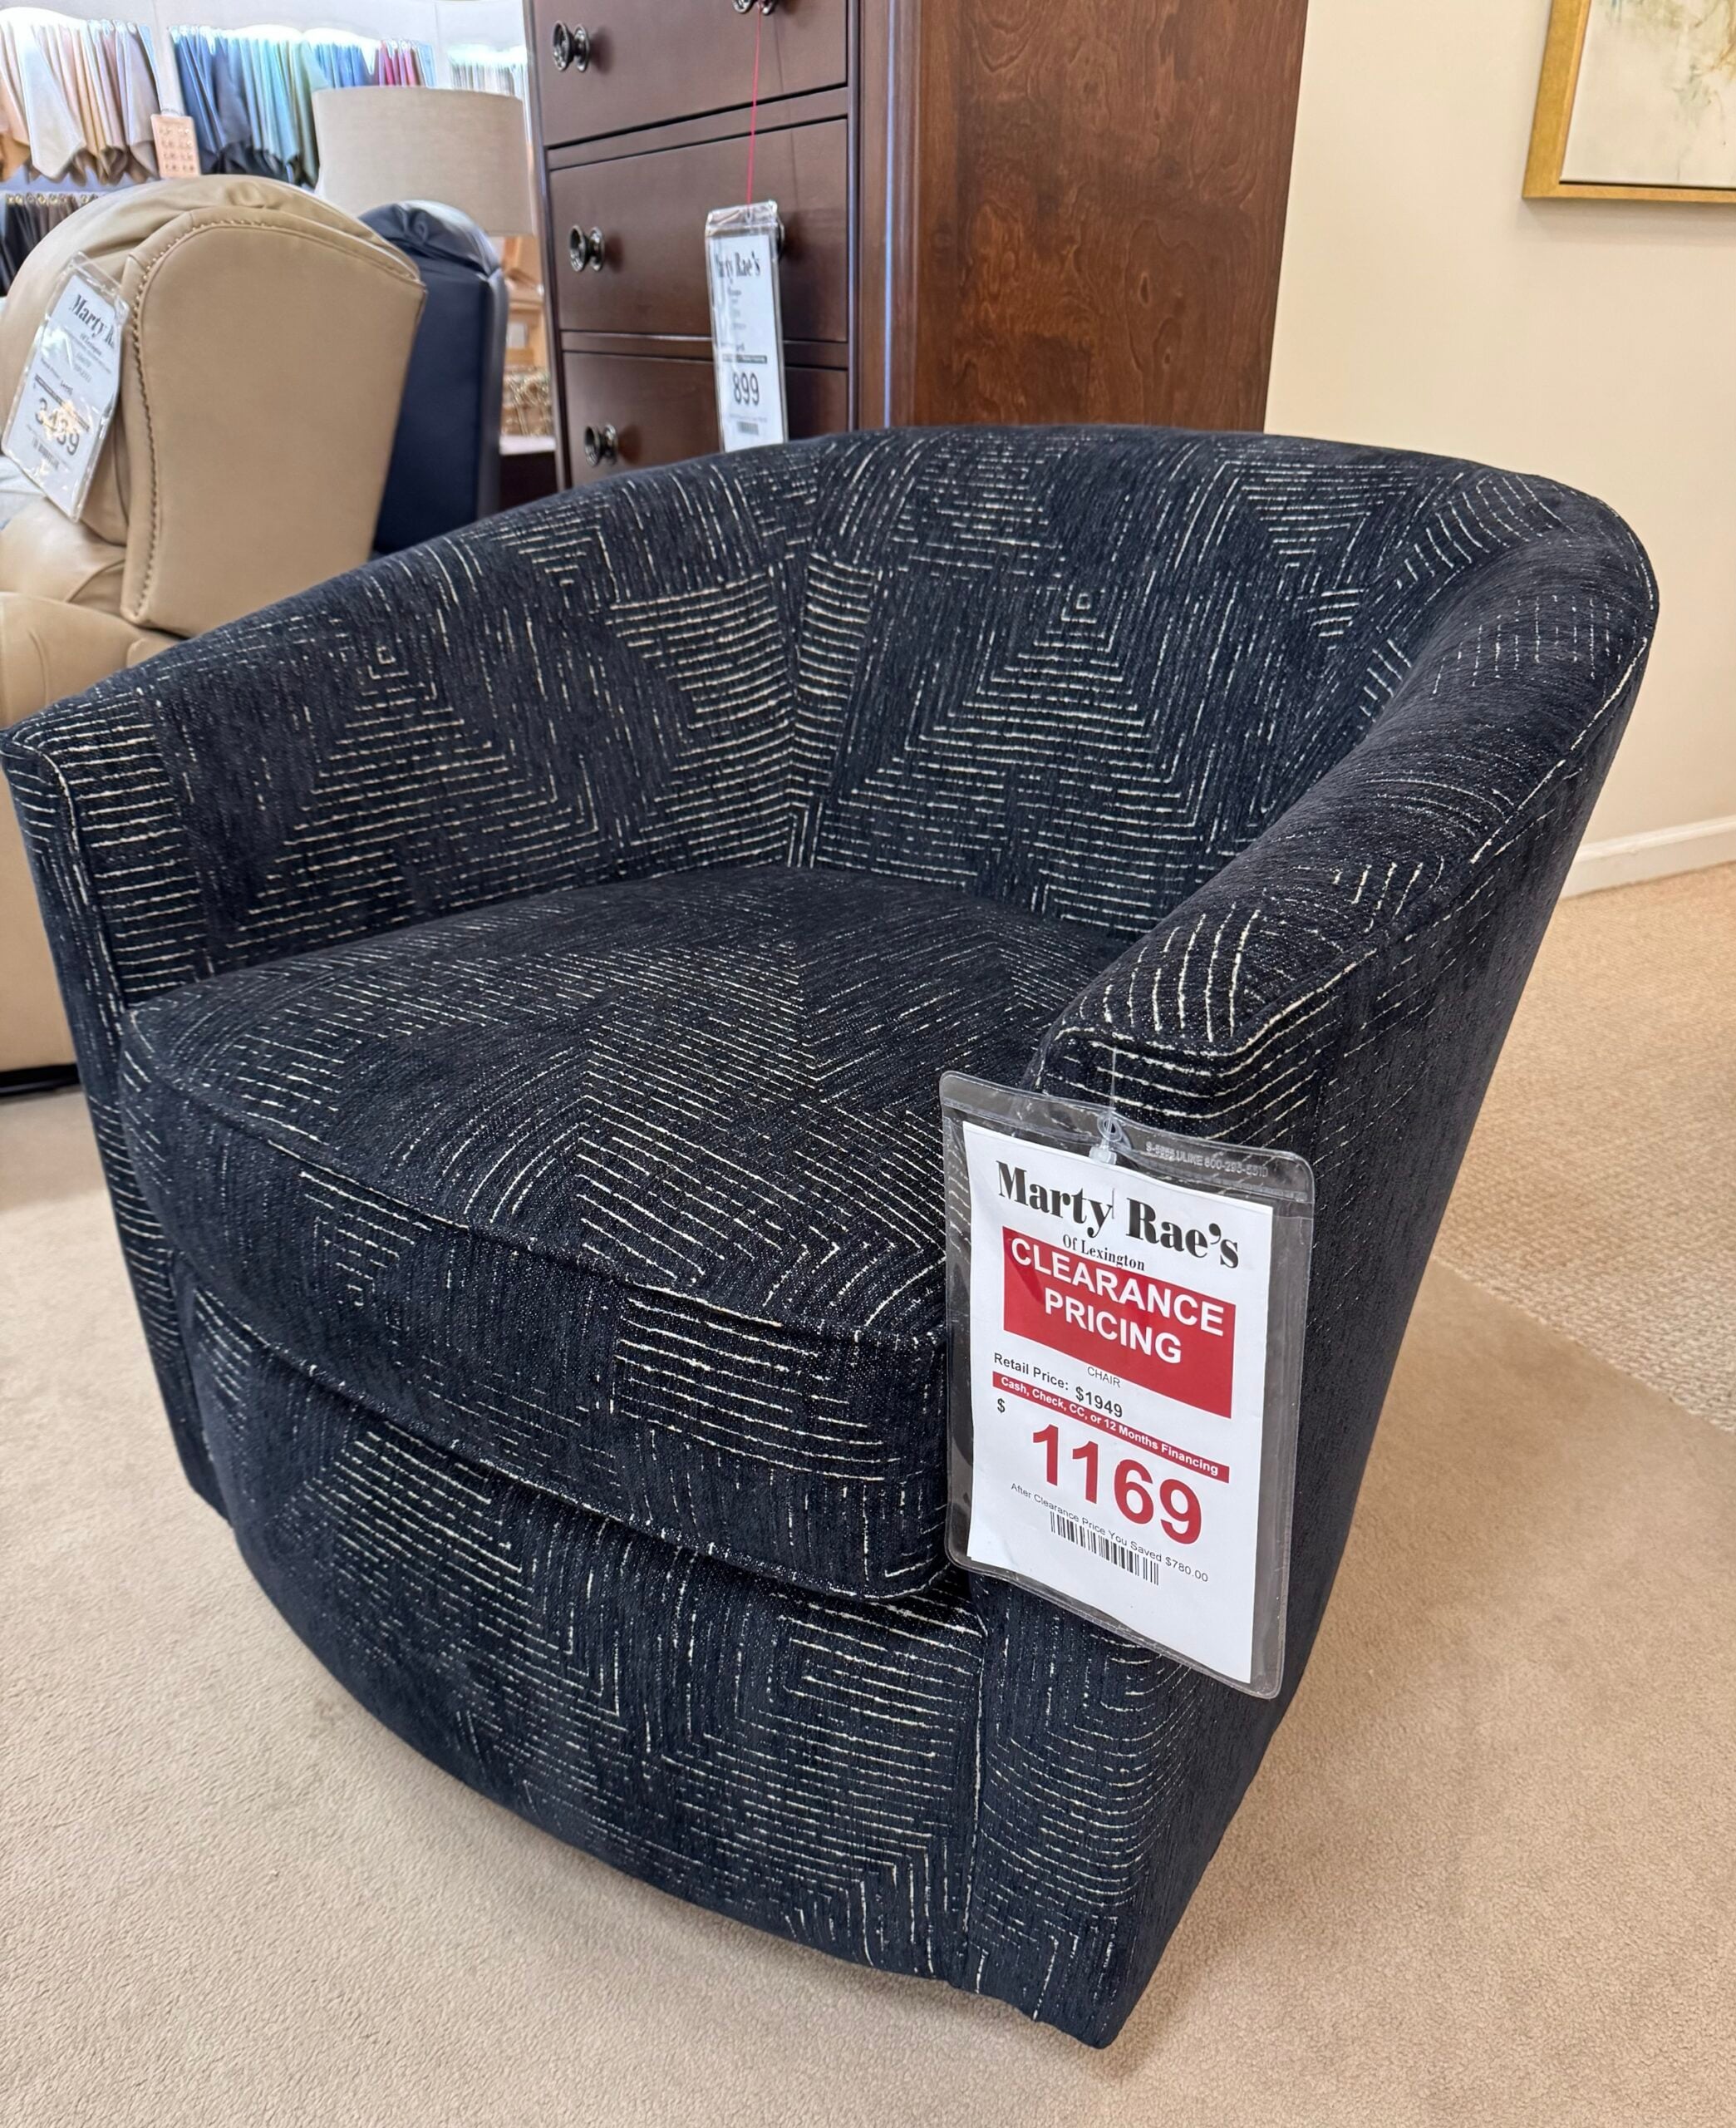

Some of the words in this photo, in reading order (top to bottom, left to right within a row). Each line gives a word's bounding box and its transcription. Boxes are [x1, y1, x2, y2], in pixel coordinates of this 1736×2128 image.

[733, 372, 760, 406] 899
[996, 1160, 1113, 1239] Marty
[1125, 1197, 1239, 1268] Rae's
[1011, 1237, 1224, 1337] CLEARANCE
[1063, 1234, 1078, 1250] Of
[1081, 1239, 1145, 1272] Lexington
[1045, 1287, 1182, 1364] PRICING
[994, 1352, 1029, 1375] Retail
[1033, 1367, 1069, 1391] Price:
[1075, 1386, 1123, 1418] $1949
[996, 1397, 1006, 1414] $
[1087, 1366, 1121, 1388] CHAIR
[1001, 1377, 1030, 1396] Cash,
[1032, 1390, 1067, 1411] Check,
[1069, 1404, 1088, 1420] CC,
[1090, 1415, 1102, 1425] or
[1104, 1419, 1117, 1431] 12
[1119, 1425, 1158, 1450] Months
[1161, 1443, 1218, 1476] Financing
[1032, 1424, 1202, 1544] 1169
[1011, 1482, 1031, 1499] After
[1034, 1495, 1079, 1523] Clearance
[1082, 1517, 1106, 1536] Price
[1109, 1530, 1128, 1547] You
[1130, 1540, 1163, 1563] Saved
[1165, 1556, 1208, 1583] $780.00
